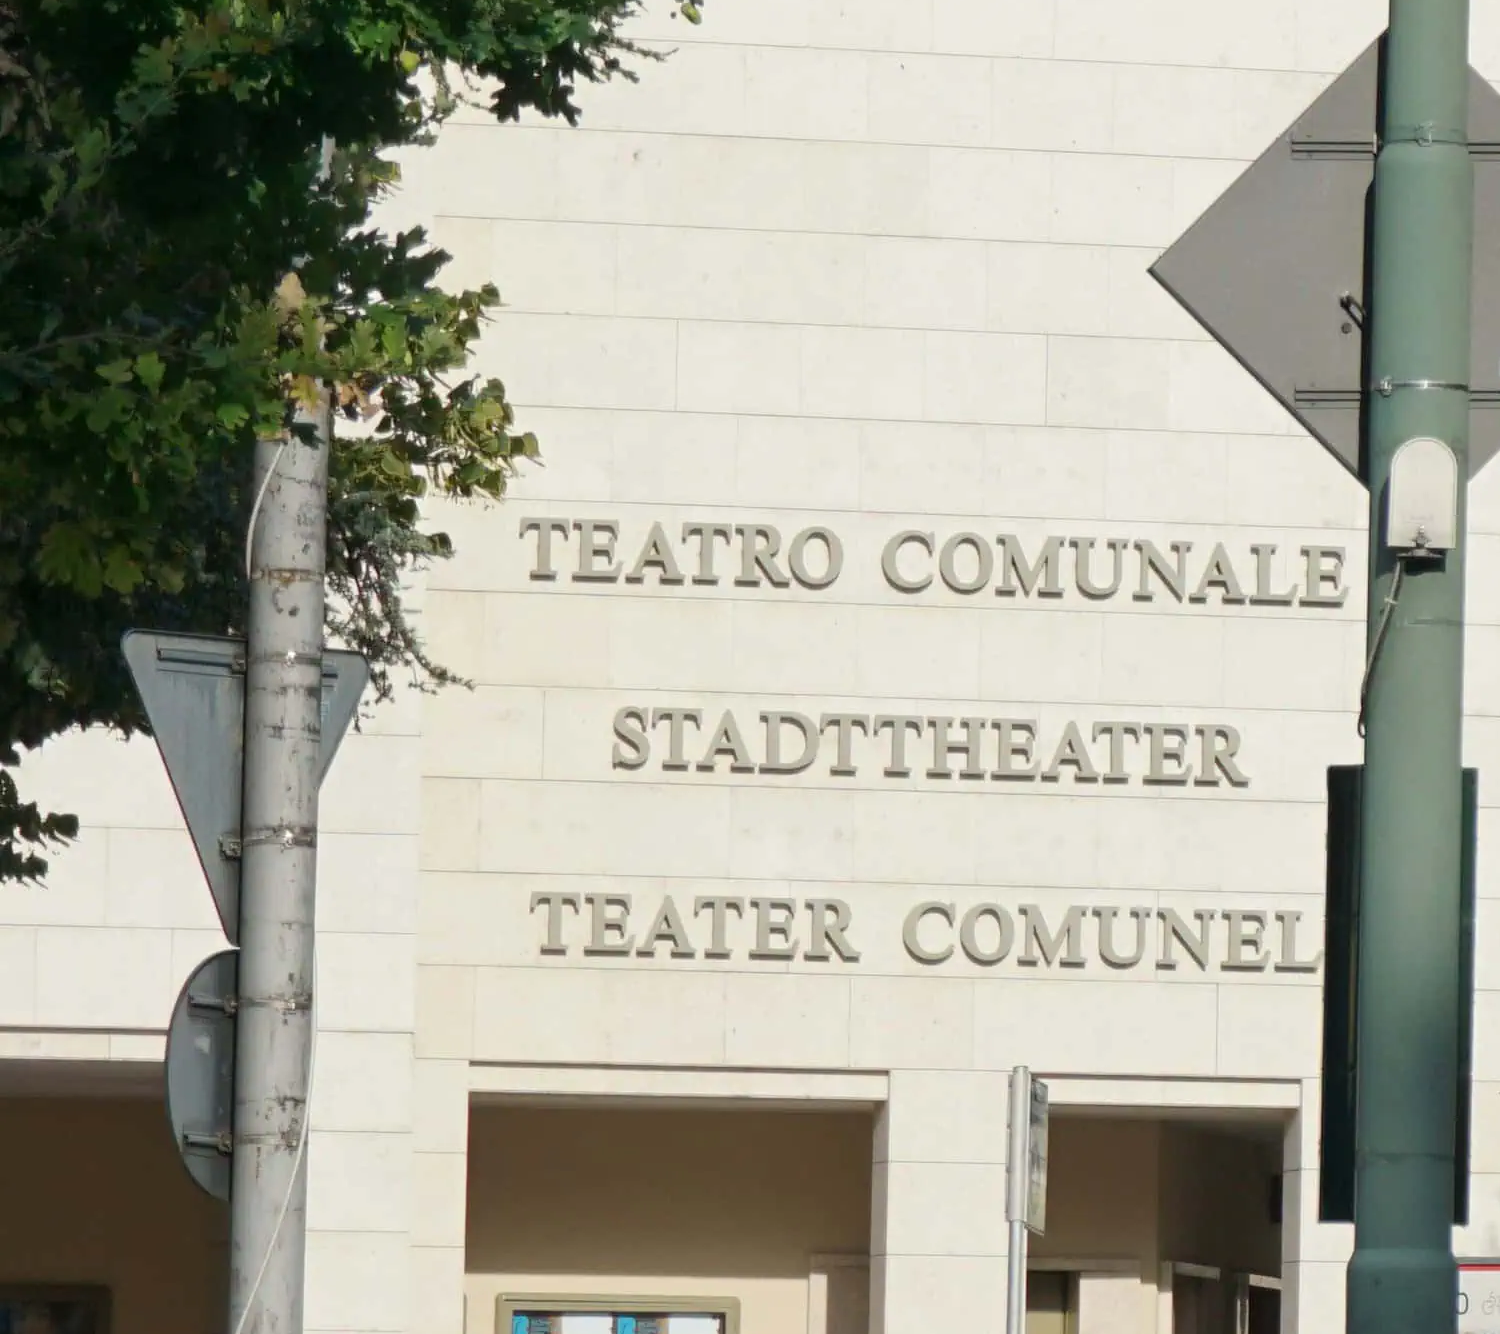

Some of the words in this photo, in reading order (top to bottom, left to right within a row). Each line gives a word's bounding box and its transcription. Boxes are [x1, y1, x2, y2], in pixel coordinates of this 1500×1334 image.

[520, 516, 843, 589] TEATRO
[881, 529, 1350, 609] COMUNALE
[612, 704, 1250, 789] STADTTHEATER
[530, 890, 861, 965] TEATER
